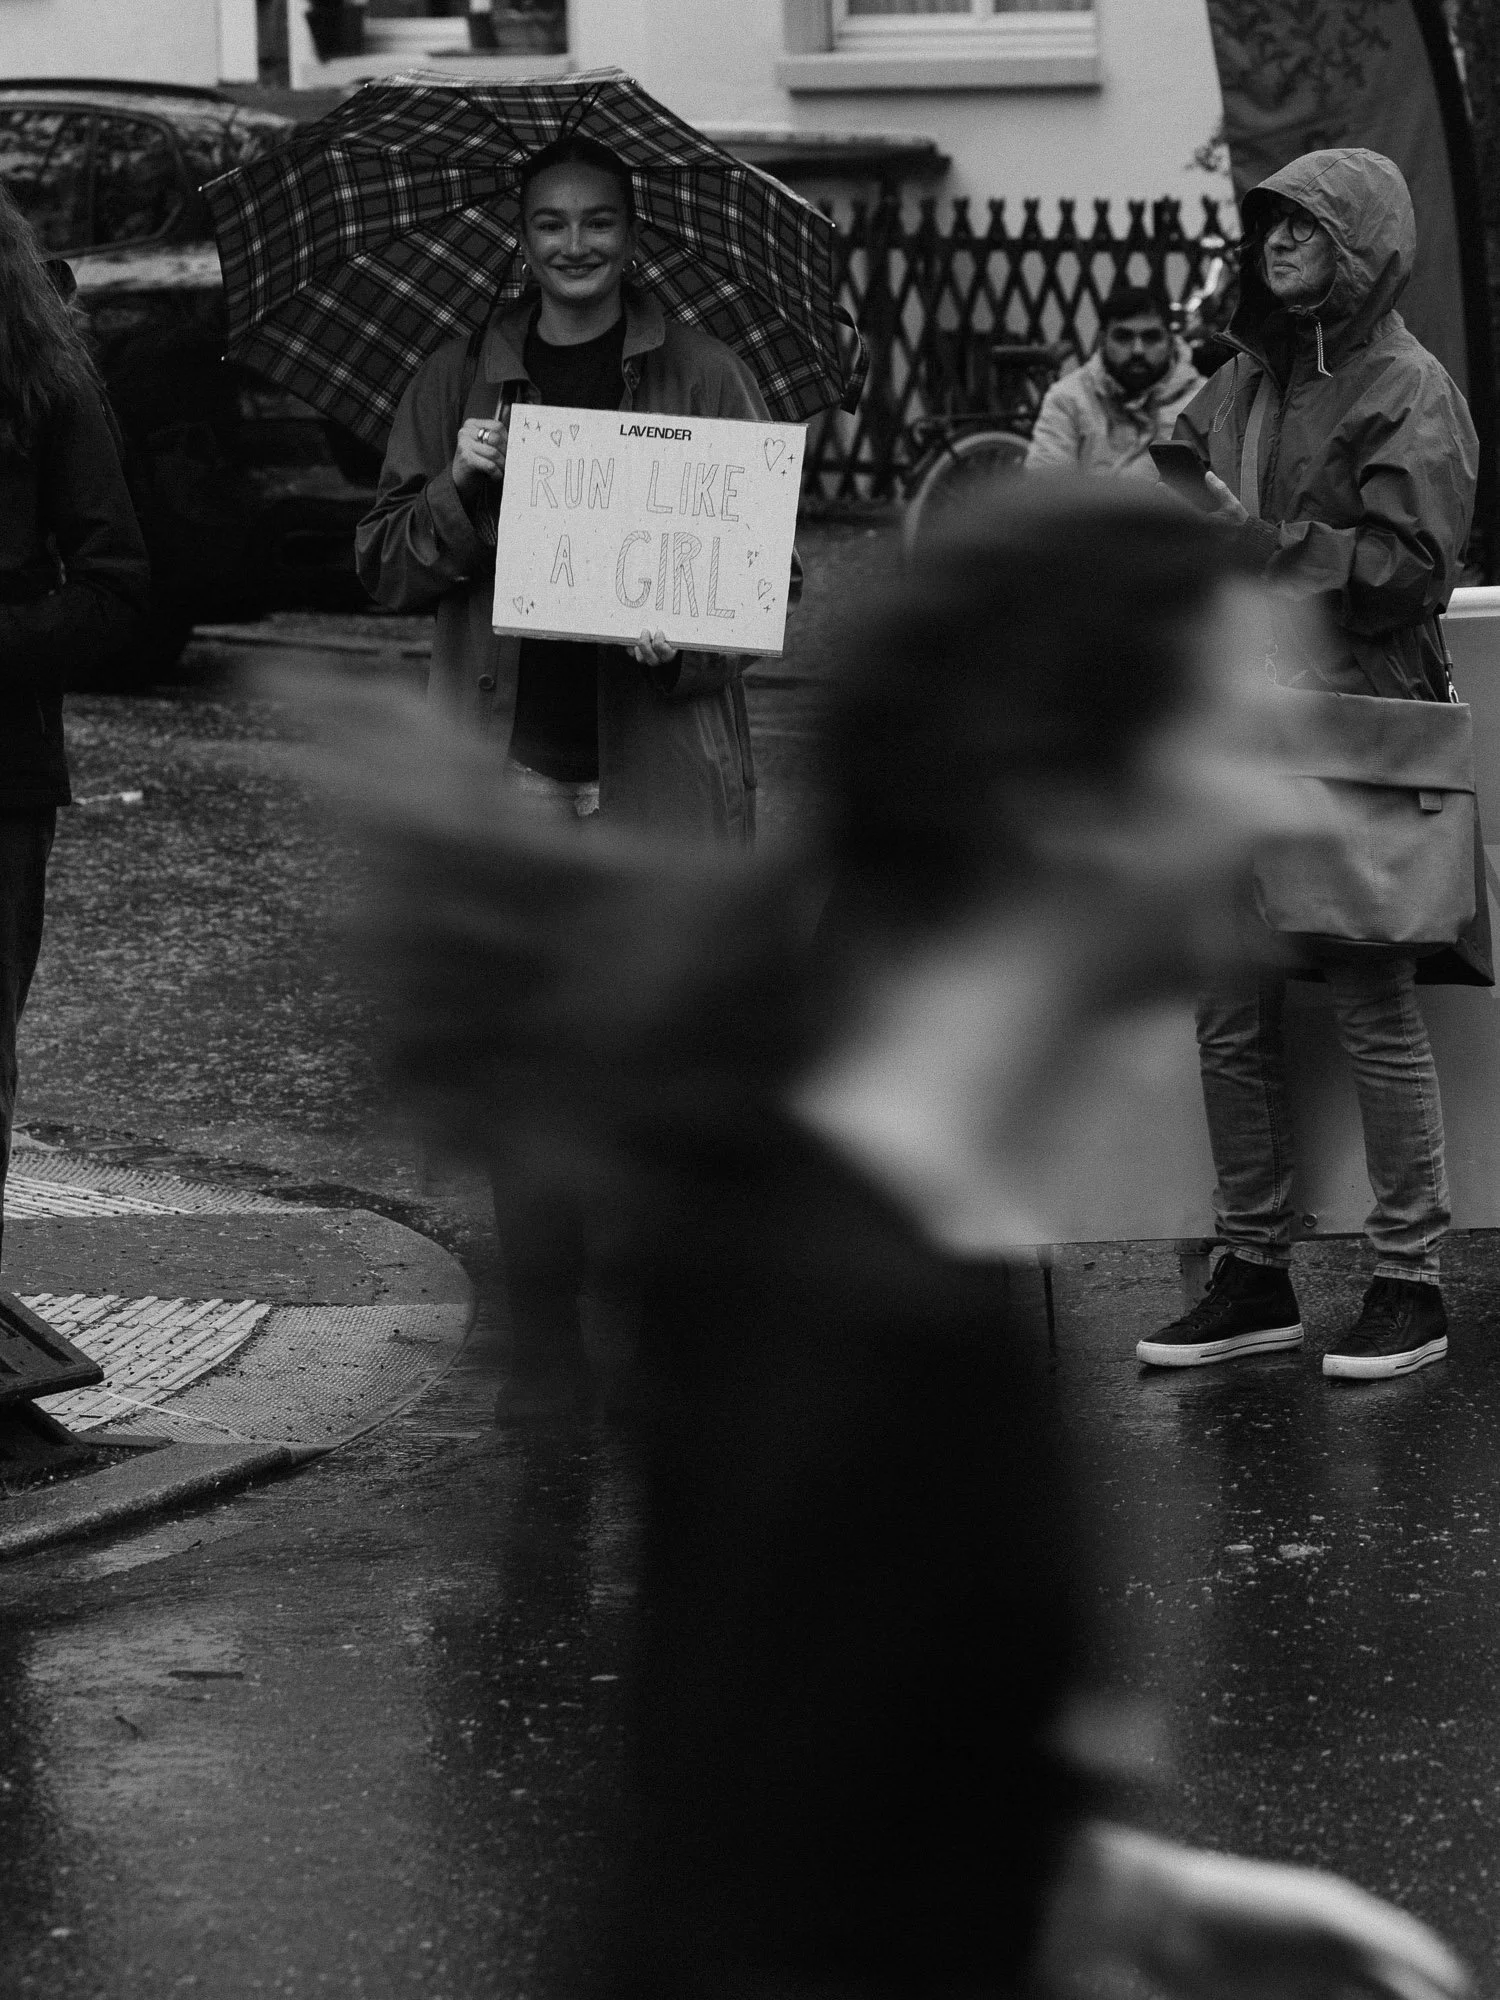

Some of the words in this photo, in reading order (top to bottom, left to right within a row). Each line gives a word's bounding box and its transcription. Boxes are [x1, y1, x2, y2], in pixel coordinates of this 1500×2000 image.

[620, 424, 692, 441] LAVENDER
[530, 457, 615, 509] RUN
[646, 460, 745, 522] LIKE
[550, 534, 574, 587] A
[615, 530, 736, 619] GIRL
